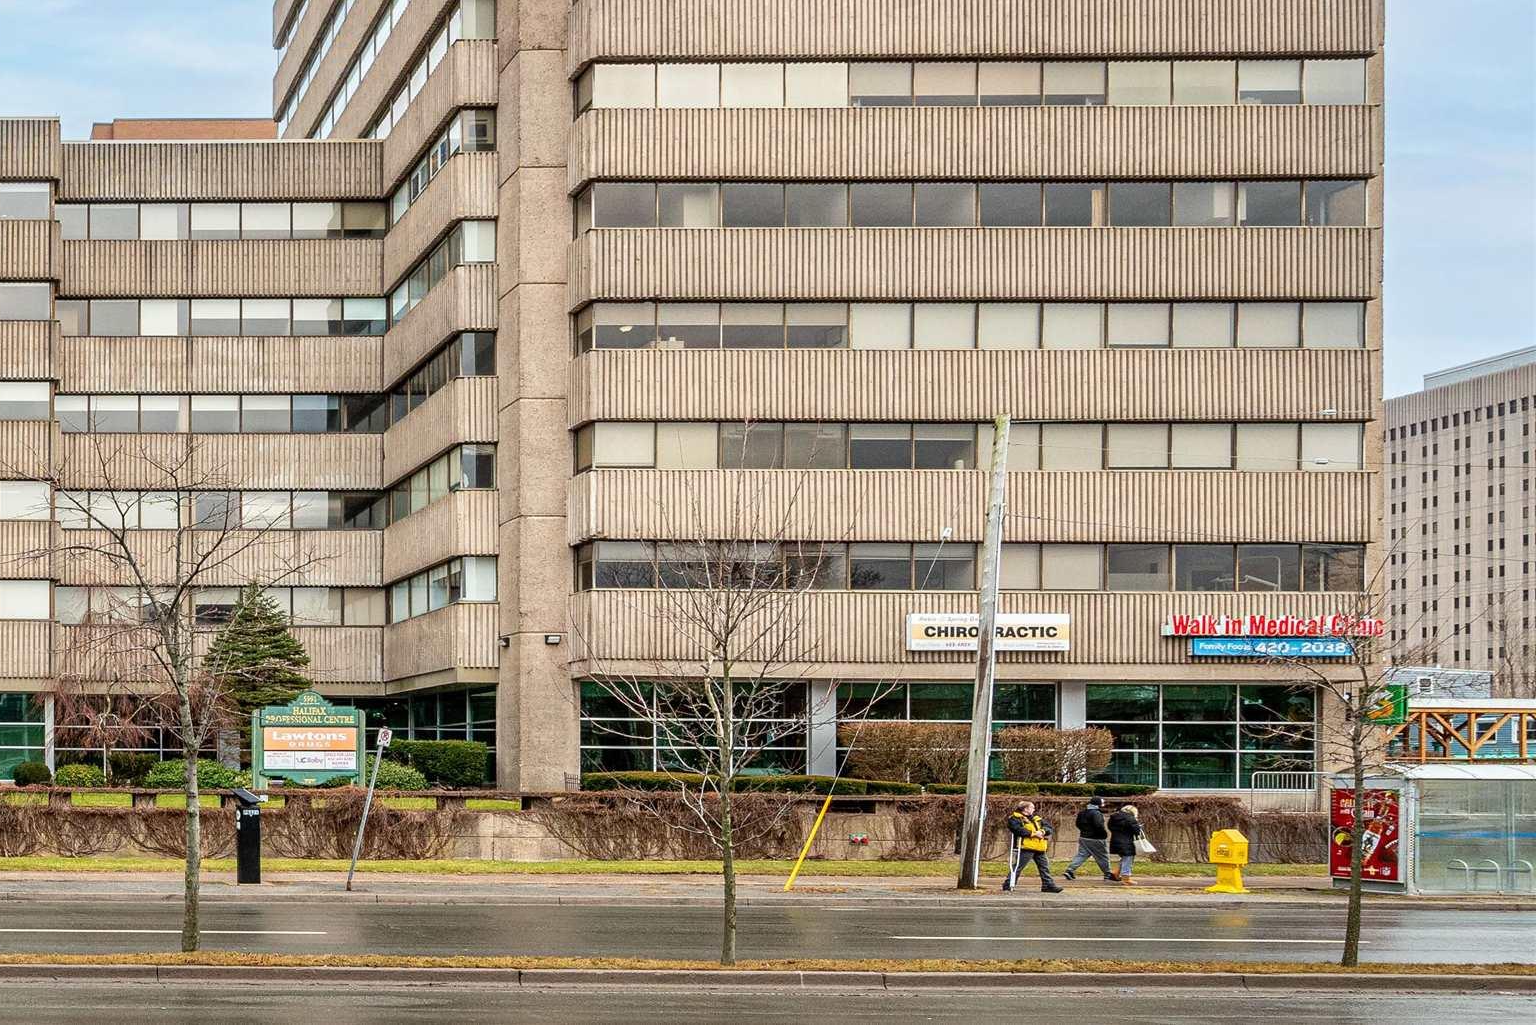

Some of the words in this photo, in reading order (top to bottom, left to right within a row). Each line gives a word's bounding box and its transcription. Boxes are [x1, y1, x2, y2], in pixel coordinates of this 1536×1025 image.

[1172, 615, 1217, 636] Walk
[1225, 615, 1242, 635] in
[1249, 615, 1325, 636] Medical
[924, 626, 1058, 638] CHIRORACTIC
[293, 706, 326, 715] HALIFAX
[324, 715, 355, 724] CENTRE
[272, 731, 347, 741] Lawtons
